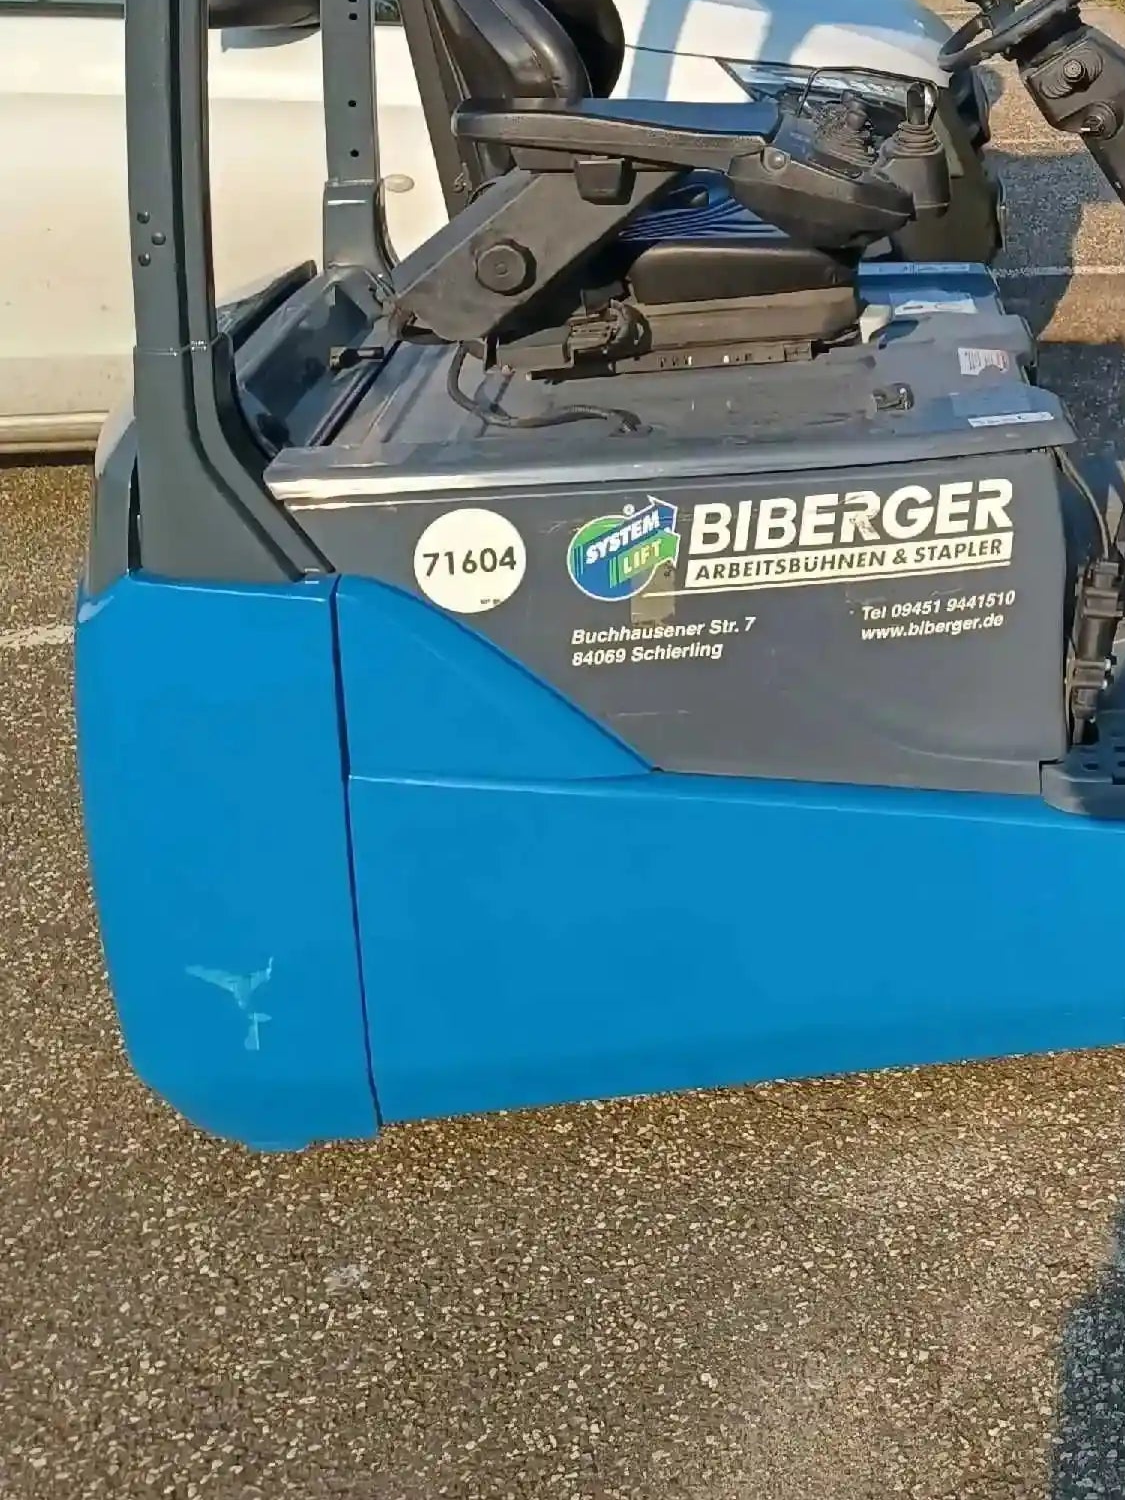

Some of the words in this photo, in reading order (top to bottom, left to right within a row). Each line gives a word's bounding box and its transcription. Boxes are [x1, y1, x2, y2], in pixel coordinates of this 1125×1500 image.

[689, 478, 1013, 555] BIBERGER
[585, 508, 660, 565] SYSTEM
[422, 545, 517, 577] 71604
[623, 539, 662, 574] LIFT
[695, 550, 886, 581] ARBEITSBÜHNEN
[891, 549, 908, 565] &
[914, 538, 1003, 564] STAPLER
[862, 605, 886, 621] Tel
[891, 599, 940, 618] 09451
[947, 590, 1015, 612] 9441510
[571, 622, 706, 645] Buchhausener
[709, 619, 740, 635] Str.
[744, 616, 757, 632] 7
[861, 613, 1004, 640] www.biberger.de
[571, 648, 627, 667] 84069
[630, 642, 723, 660] Schierling
